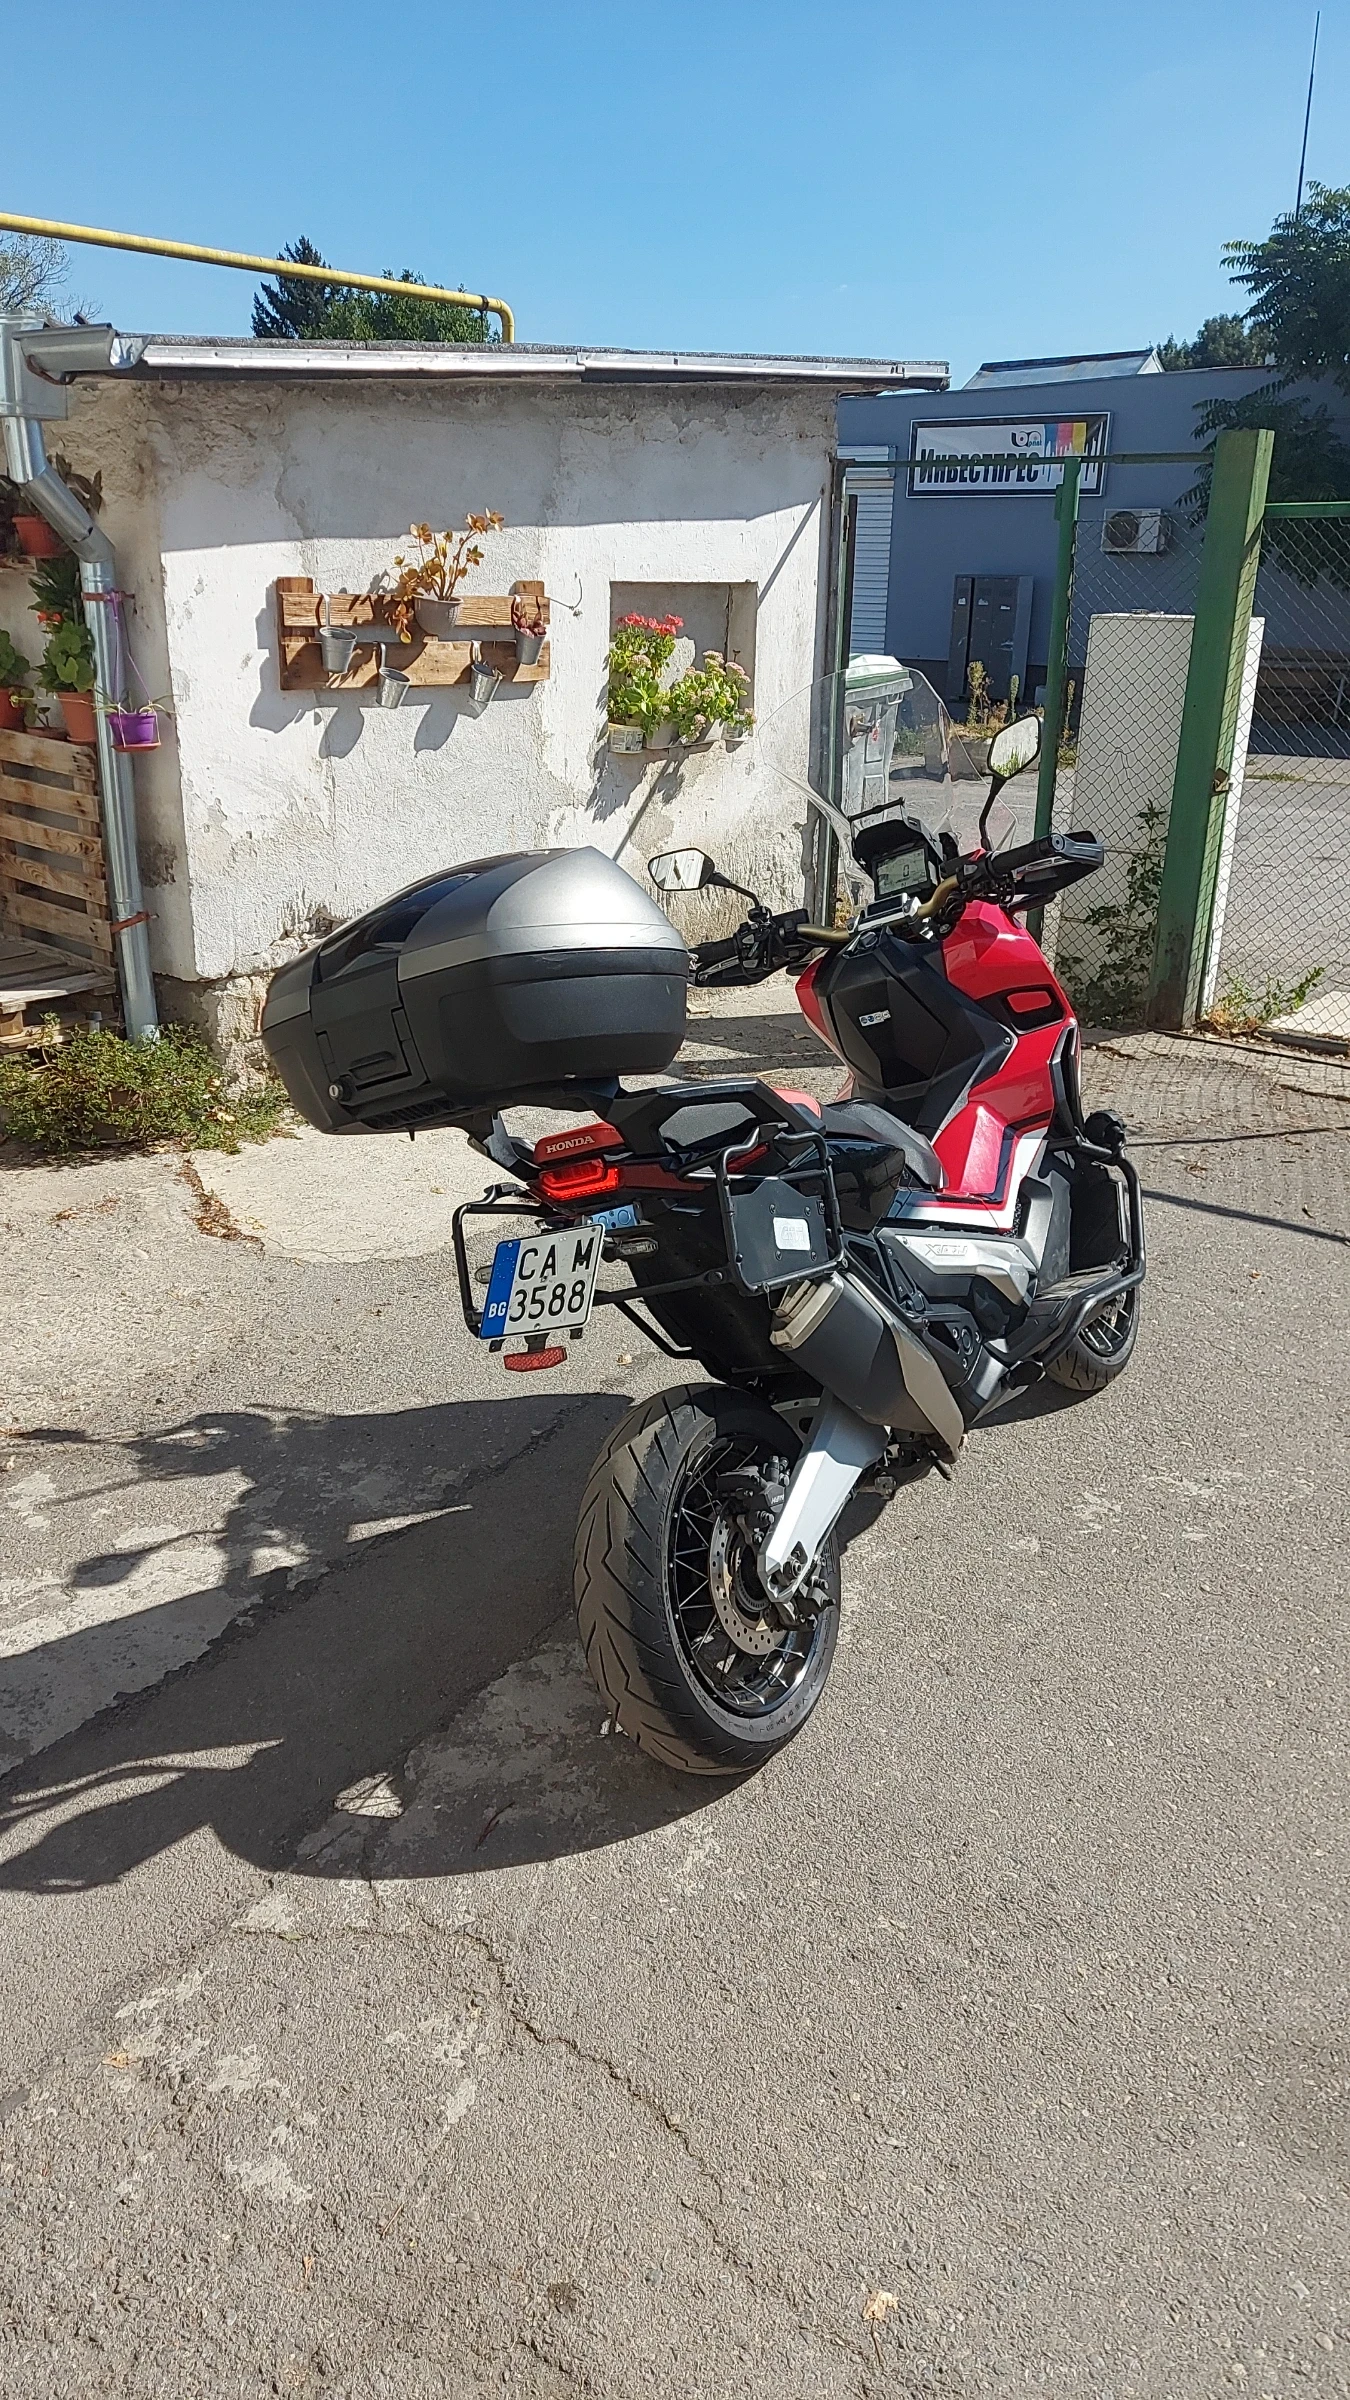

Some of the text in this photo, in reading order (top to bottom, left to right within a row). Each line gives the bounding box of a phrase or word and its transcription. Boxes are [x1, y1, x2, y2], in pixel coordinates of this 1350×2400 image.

[545, 1135, 595, 1154] HONDA
[518, 1236, 595, 1281] CA M
[488, 1302, 507, 1318] BG
[508, 1279, 586, 1322] 3588
